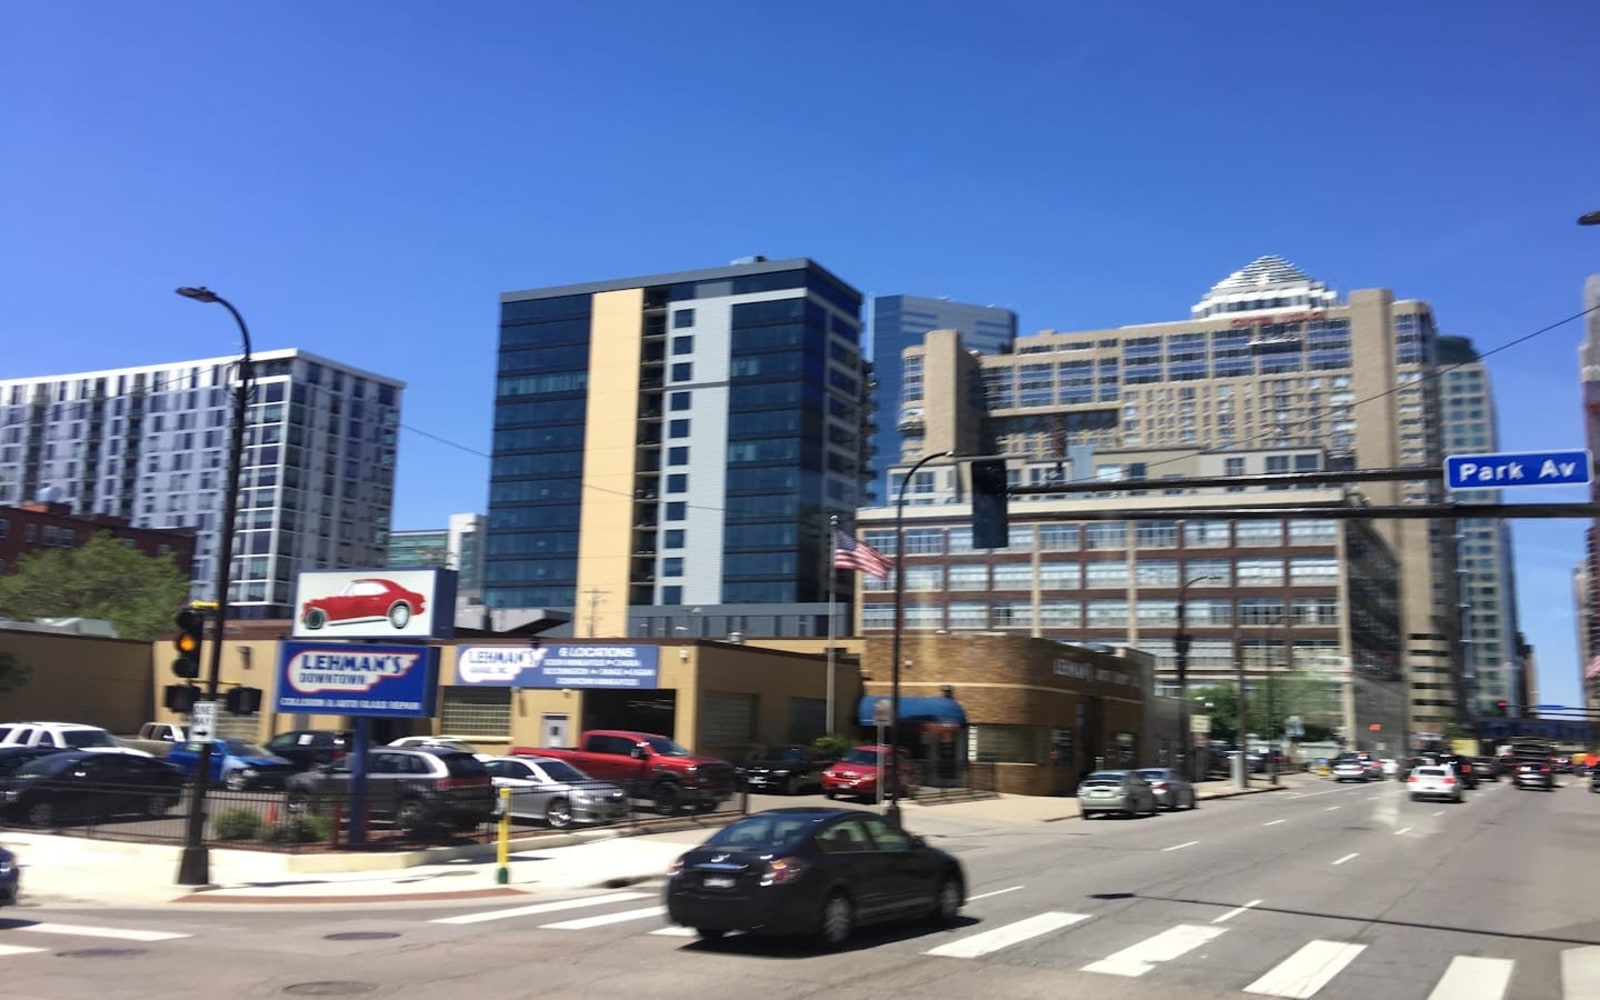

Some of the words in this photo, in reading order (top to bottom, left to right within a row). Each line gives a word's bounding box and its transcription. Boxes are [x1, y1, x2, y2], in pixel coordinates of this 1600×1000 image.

[1459, 461, 1525, 482] Park
[1538, 459, 1577, 478] Av
[568, 648, 637, 657] LOCATIONS
[302, 654, 402, 673] LEHMAN'S
[300, 673, 365, 684] DOWNTOWN
[194, 705, 213, 713] ONE
